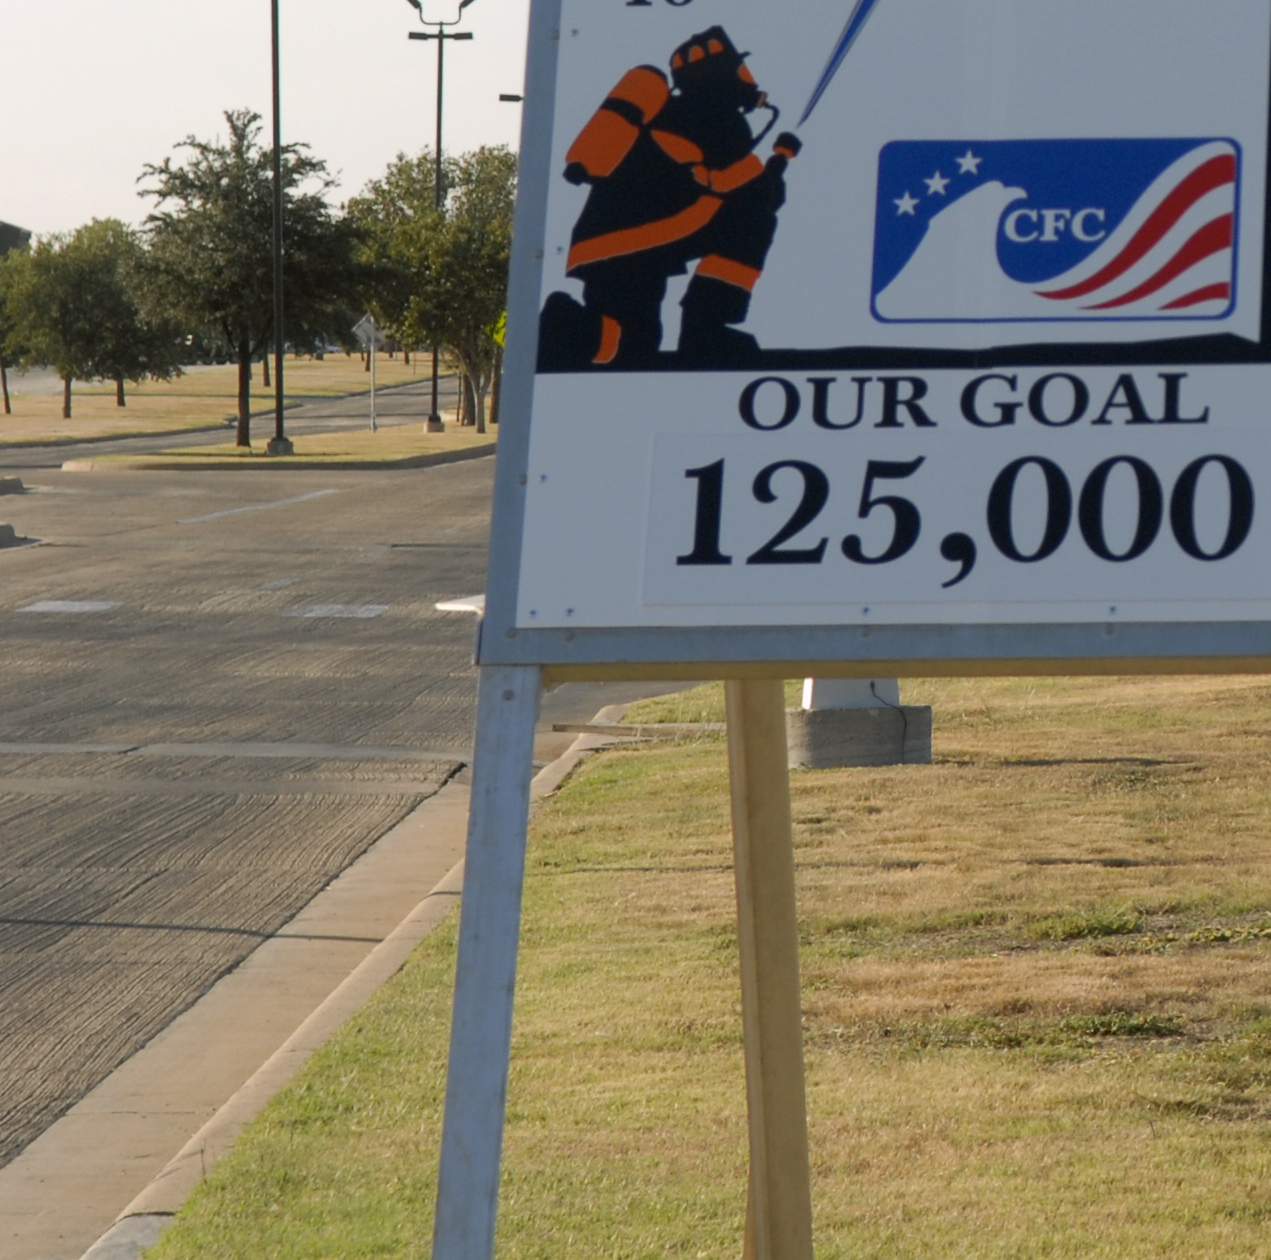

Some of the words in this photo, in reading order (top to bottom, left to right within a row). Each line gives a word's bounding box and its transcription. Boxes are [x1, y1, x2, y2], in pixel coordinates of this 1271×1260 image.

[1003, 207, 1107, 244] CFC
[738, 375, 938, 432] OUR
[959, 372, 1211, 430] GOAL
[675, 453, 1257, 590] 125,000
